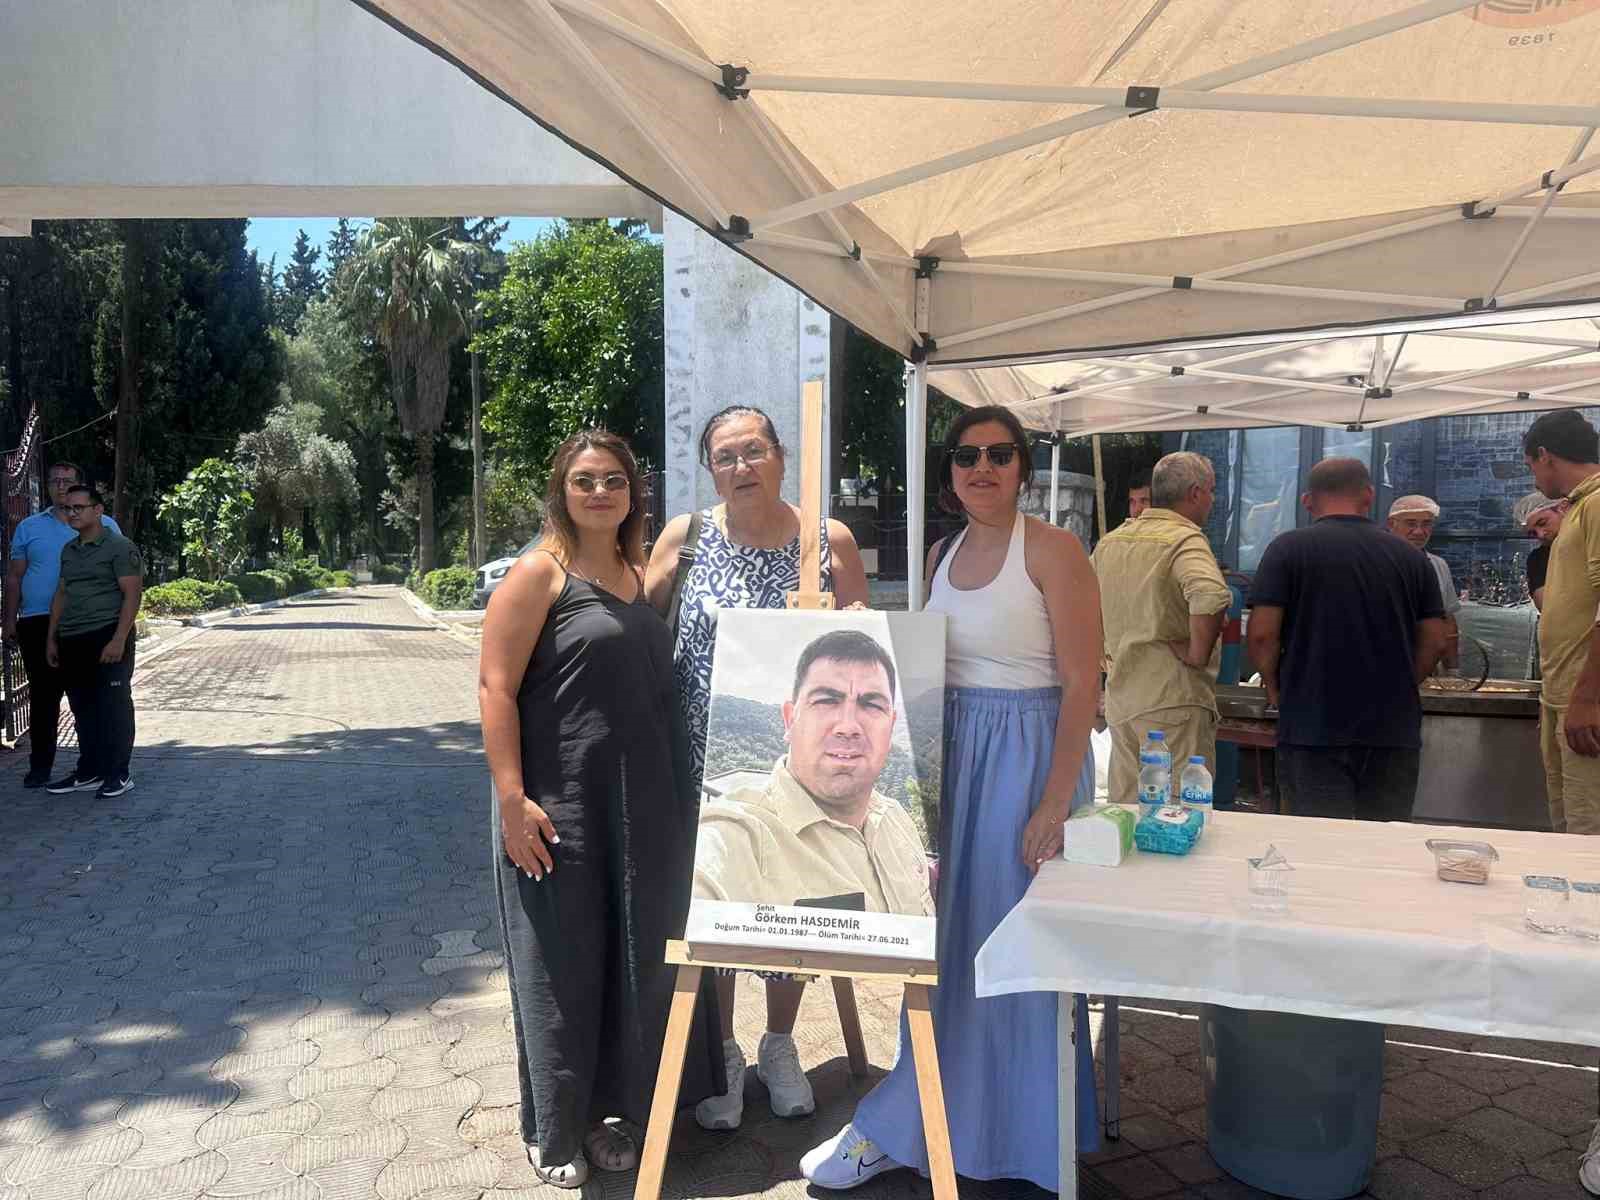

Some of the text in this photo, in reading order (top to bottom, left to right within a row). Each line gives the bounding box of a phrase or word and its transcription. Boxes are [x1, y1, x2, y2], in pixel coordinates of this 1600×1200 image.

[755, 912, 860, 930] Görkem HASDEMİR
[714, 922, 740, 932] Doğum
[818, 928, 839, 940] Ölüm
[867, 934, 909, 946] 27.06.2021
